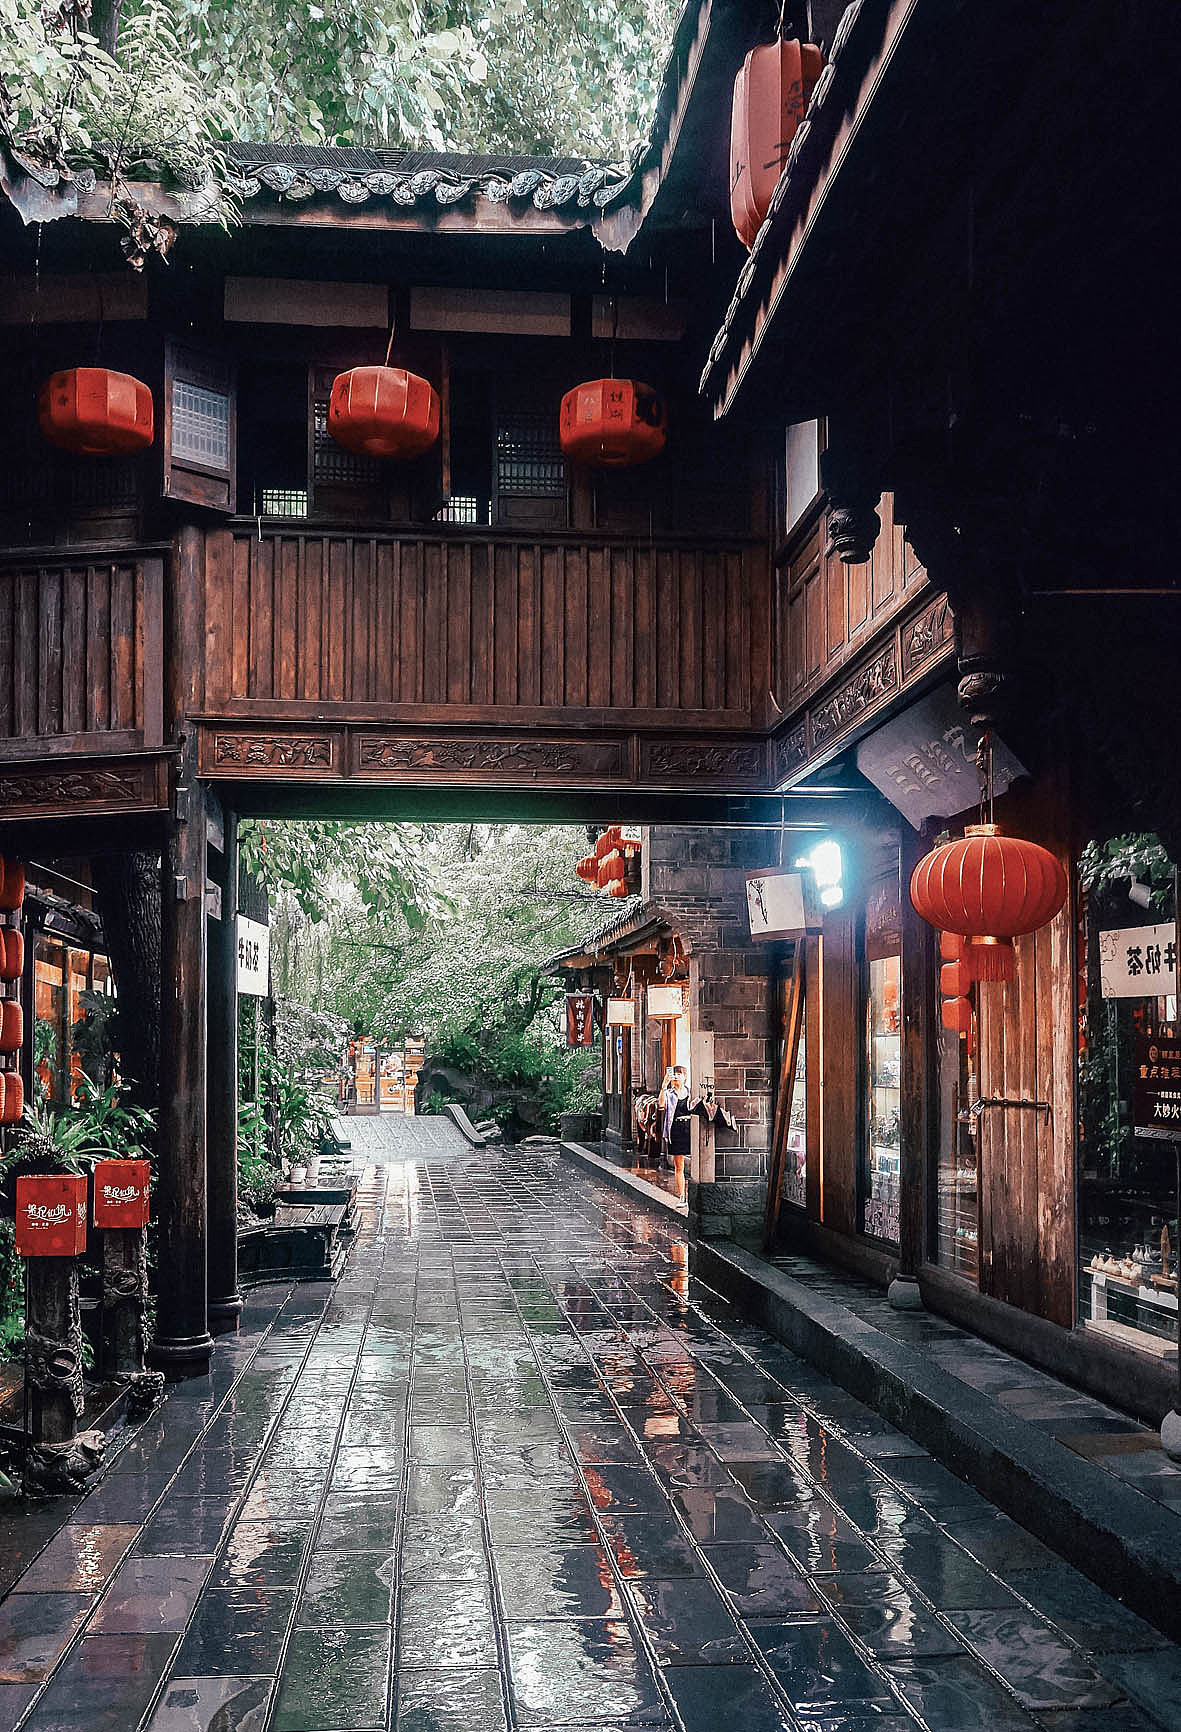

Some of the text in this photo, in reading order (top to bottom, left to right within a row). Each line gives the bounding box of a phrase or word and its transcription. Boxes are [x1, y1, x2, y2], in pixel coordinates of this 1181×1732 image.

[238, 937, 259, 973] 牛奶茶
[1153, 1102, 1181, 1119] 大妙火
